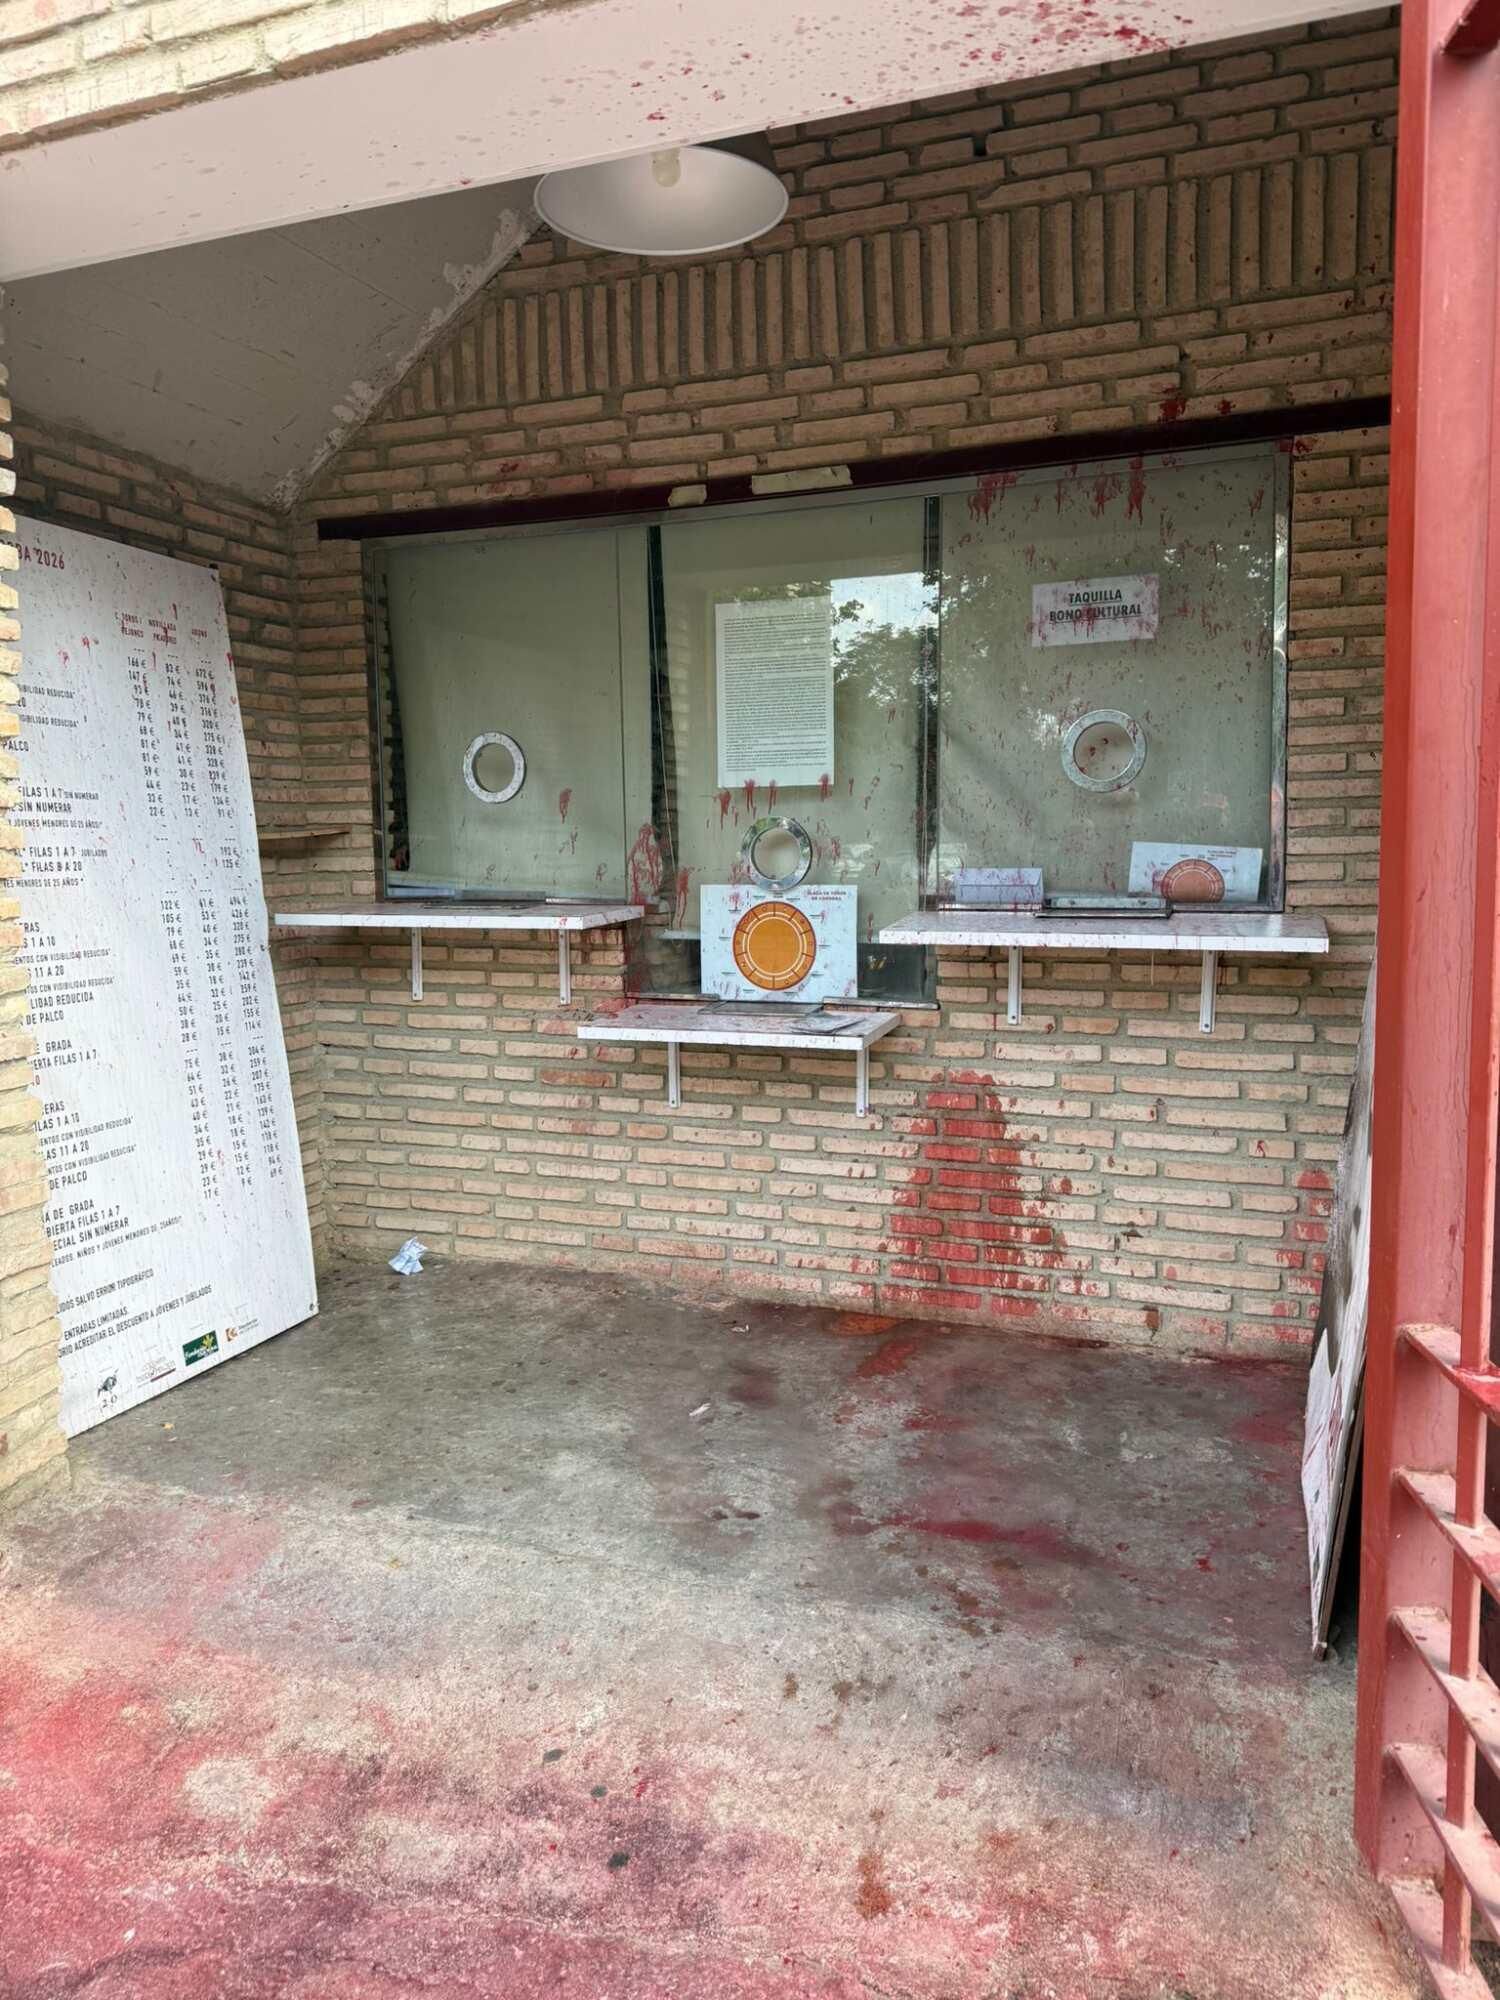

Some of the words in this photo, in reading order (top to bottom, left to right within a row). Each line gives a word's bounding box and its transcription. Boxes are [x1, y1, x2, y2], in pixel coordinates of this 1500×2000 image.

[36, 547, 65, 570] 2026
[1068, 588, 1122, 604] TAQUILLA
[1049, 607, 1082, 622] BONO
[3, 740, 29, 752] PALCO
[19, 802, 32, 812] SIN
[36, 802, 72, 813] NUMERAR
[29, 846, 53, 858] FILAS
[63, 847, 69, 857] A
[31, 861, 55, 873] FILAS
[65, 862, 71, 872] A
[43, 879, 51, 888] DE
[40, 937, 45, 948] A
[36, 953, 49, 963] CON
[50, 950, 82, 961] VISIBILIDAD
[35, 966, 43, 978] 11
[47, 966, 52, 977] A
[55, 964, 64, 976] 20
[40, 983, 52, 993] CON
[53, 979, 86, 991] VISIBILIDAD
[56, 991, 95, 1006] REDUCIDA
[26, 1012, 37, 1026] DE
[40, 1009, 65, 1023] PALCO
[46, 1039, 72, 1053] GRADA
[54, 1052, 77, 1066] FILAS
[86, 1050, 91, 1060] A
[42, 1100, 65, 1115] ERAS
[64, 1115, 69, 1126] A
[61, 1131, 74, 1143] CON
[59, 1145, 69, 1157] 11
[72, 1143, 78, 1154] A
[64, 1161, 77, 1172] CON
[78, 1150, 110, 1168] VISIBILIDAD
[49, 1177, 61, 1191] DE
[62, 1170, 88, 1188] PALCO
[53, 1207, 64, 1221] DE
[69, 1199, 95, 1216] GRADA
[77, 1212, 100, 1229] FILAS
[108, 1207, 114, 1218] A
[79, 1228, 93, 1244] SIN
[95, 1216, 130, 1238] NUMERAR
[75, 1290, 96, 1307] SALVO
[64, 1320, 100, 1341] ENTRADAS
[97, 1305, 128, 1328] LIMITADAS
[74, 1328, 106, 1354] ACREDITAR
[108, 1325, 117, 1338] EL
[116, 1311, 150, 1334] DESCUENTO
[185, 1283, 213, 1306] JUBILADOS
